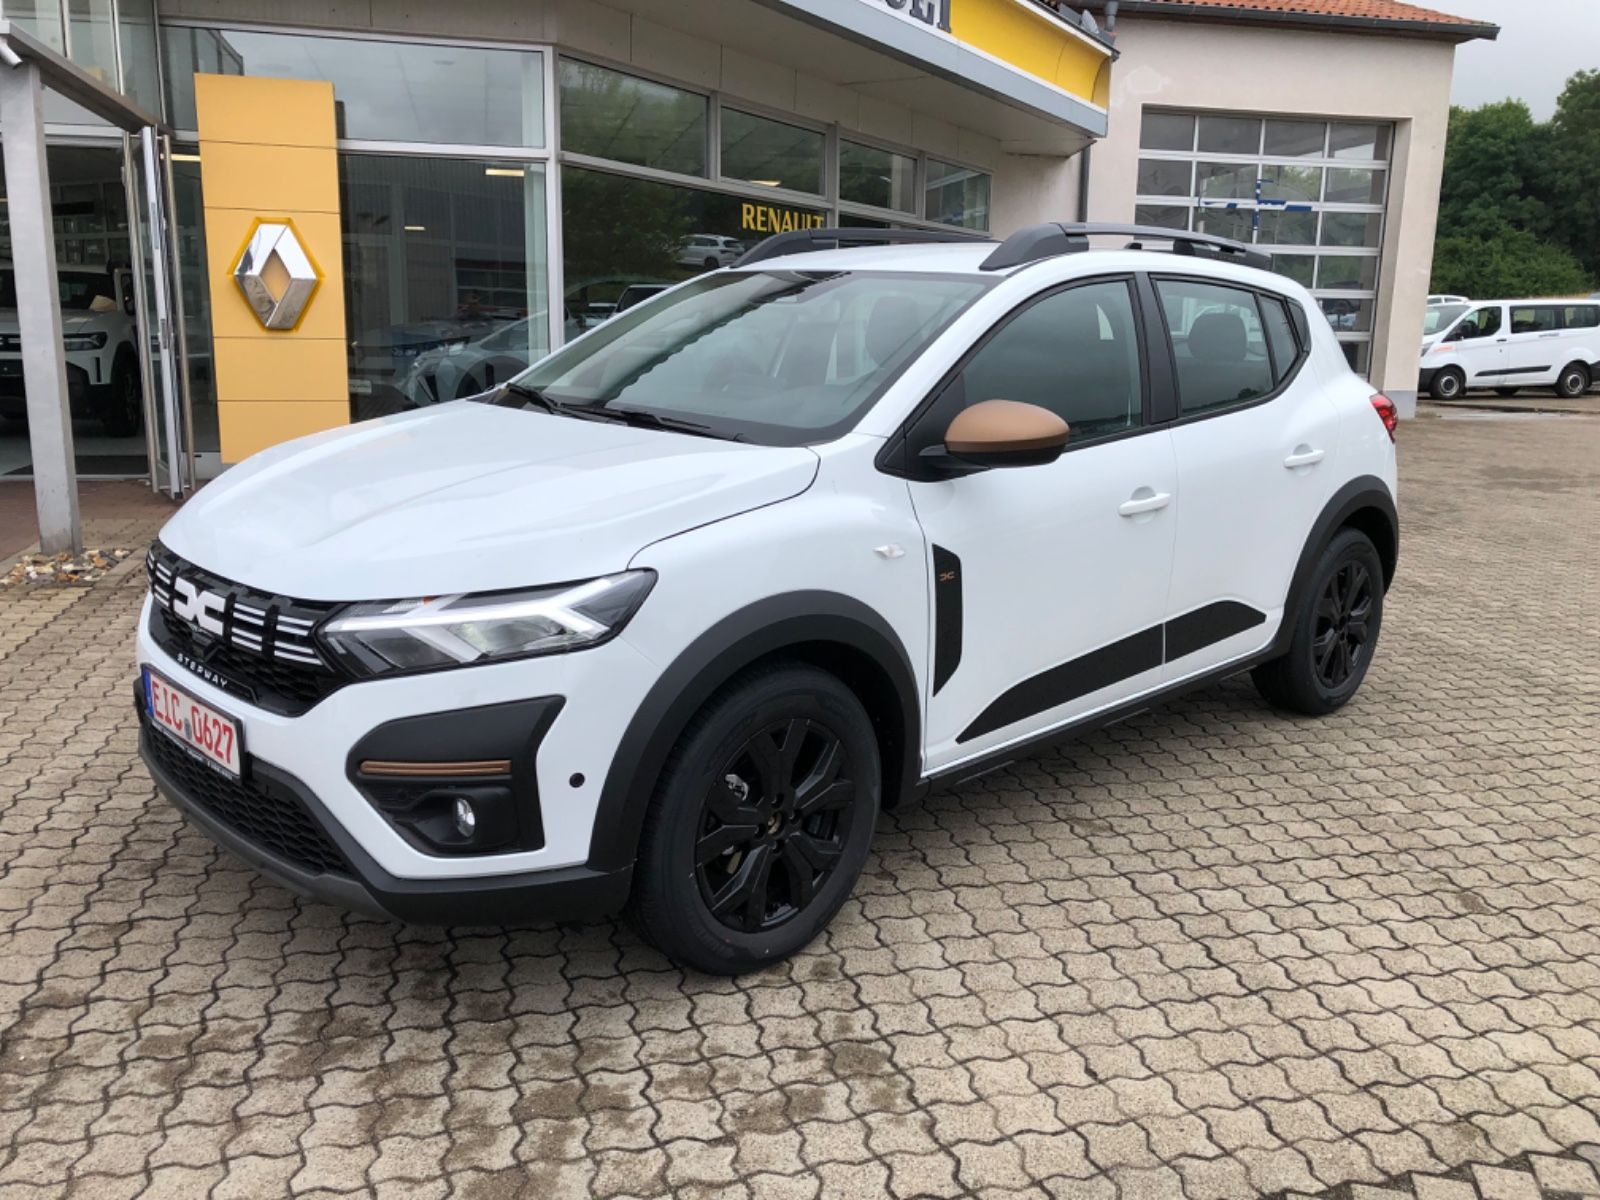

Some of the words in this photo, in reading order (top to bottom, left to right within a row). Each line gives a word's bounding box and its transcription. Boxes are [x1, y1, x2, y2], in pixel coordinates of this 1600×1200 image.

[177, 653, 228, 687] STEPWAY
[152, 680, 183, 731] EIC
[191, 705, 234, 764] 0627
